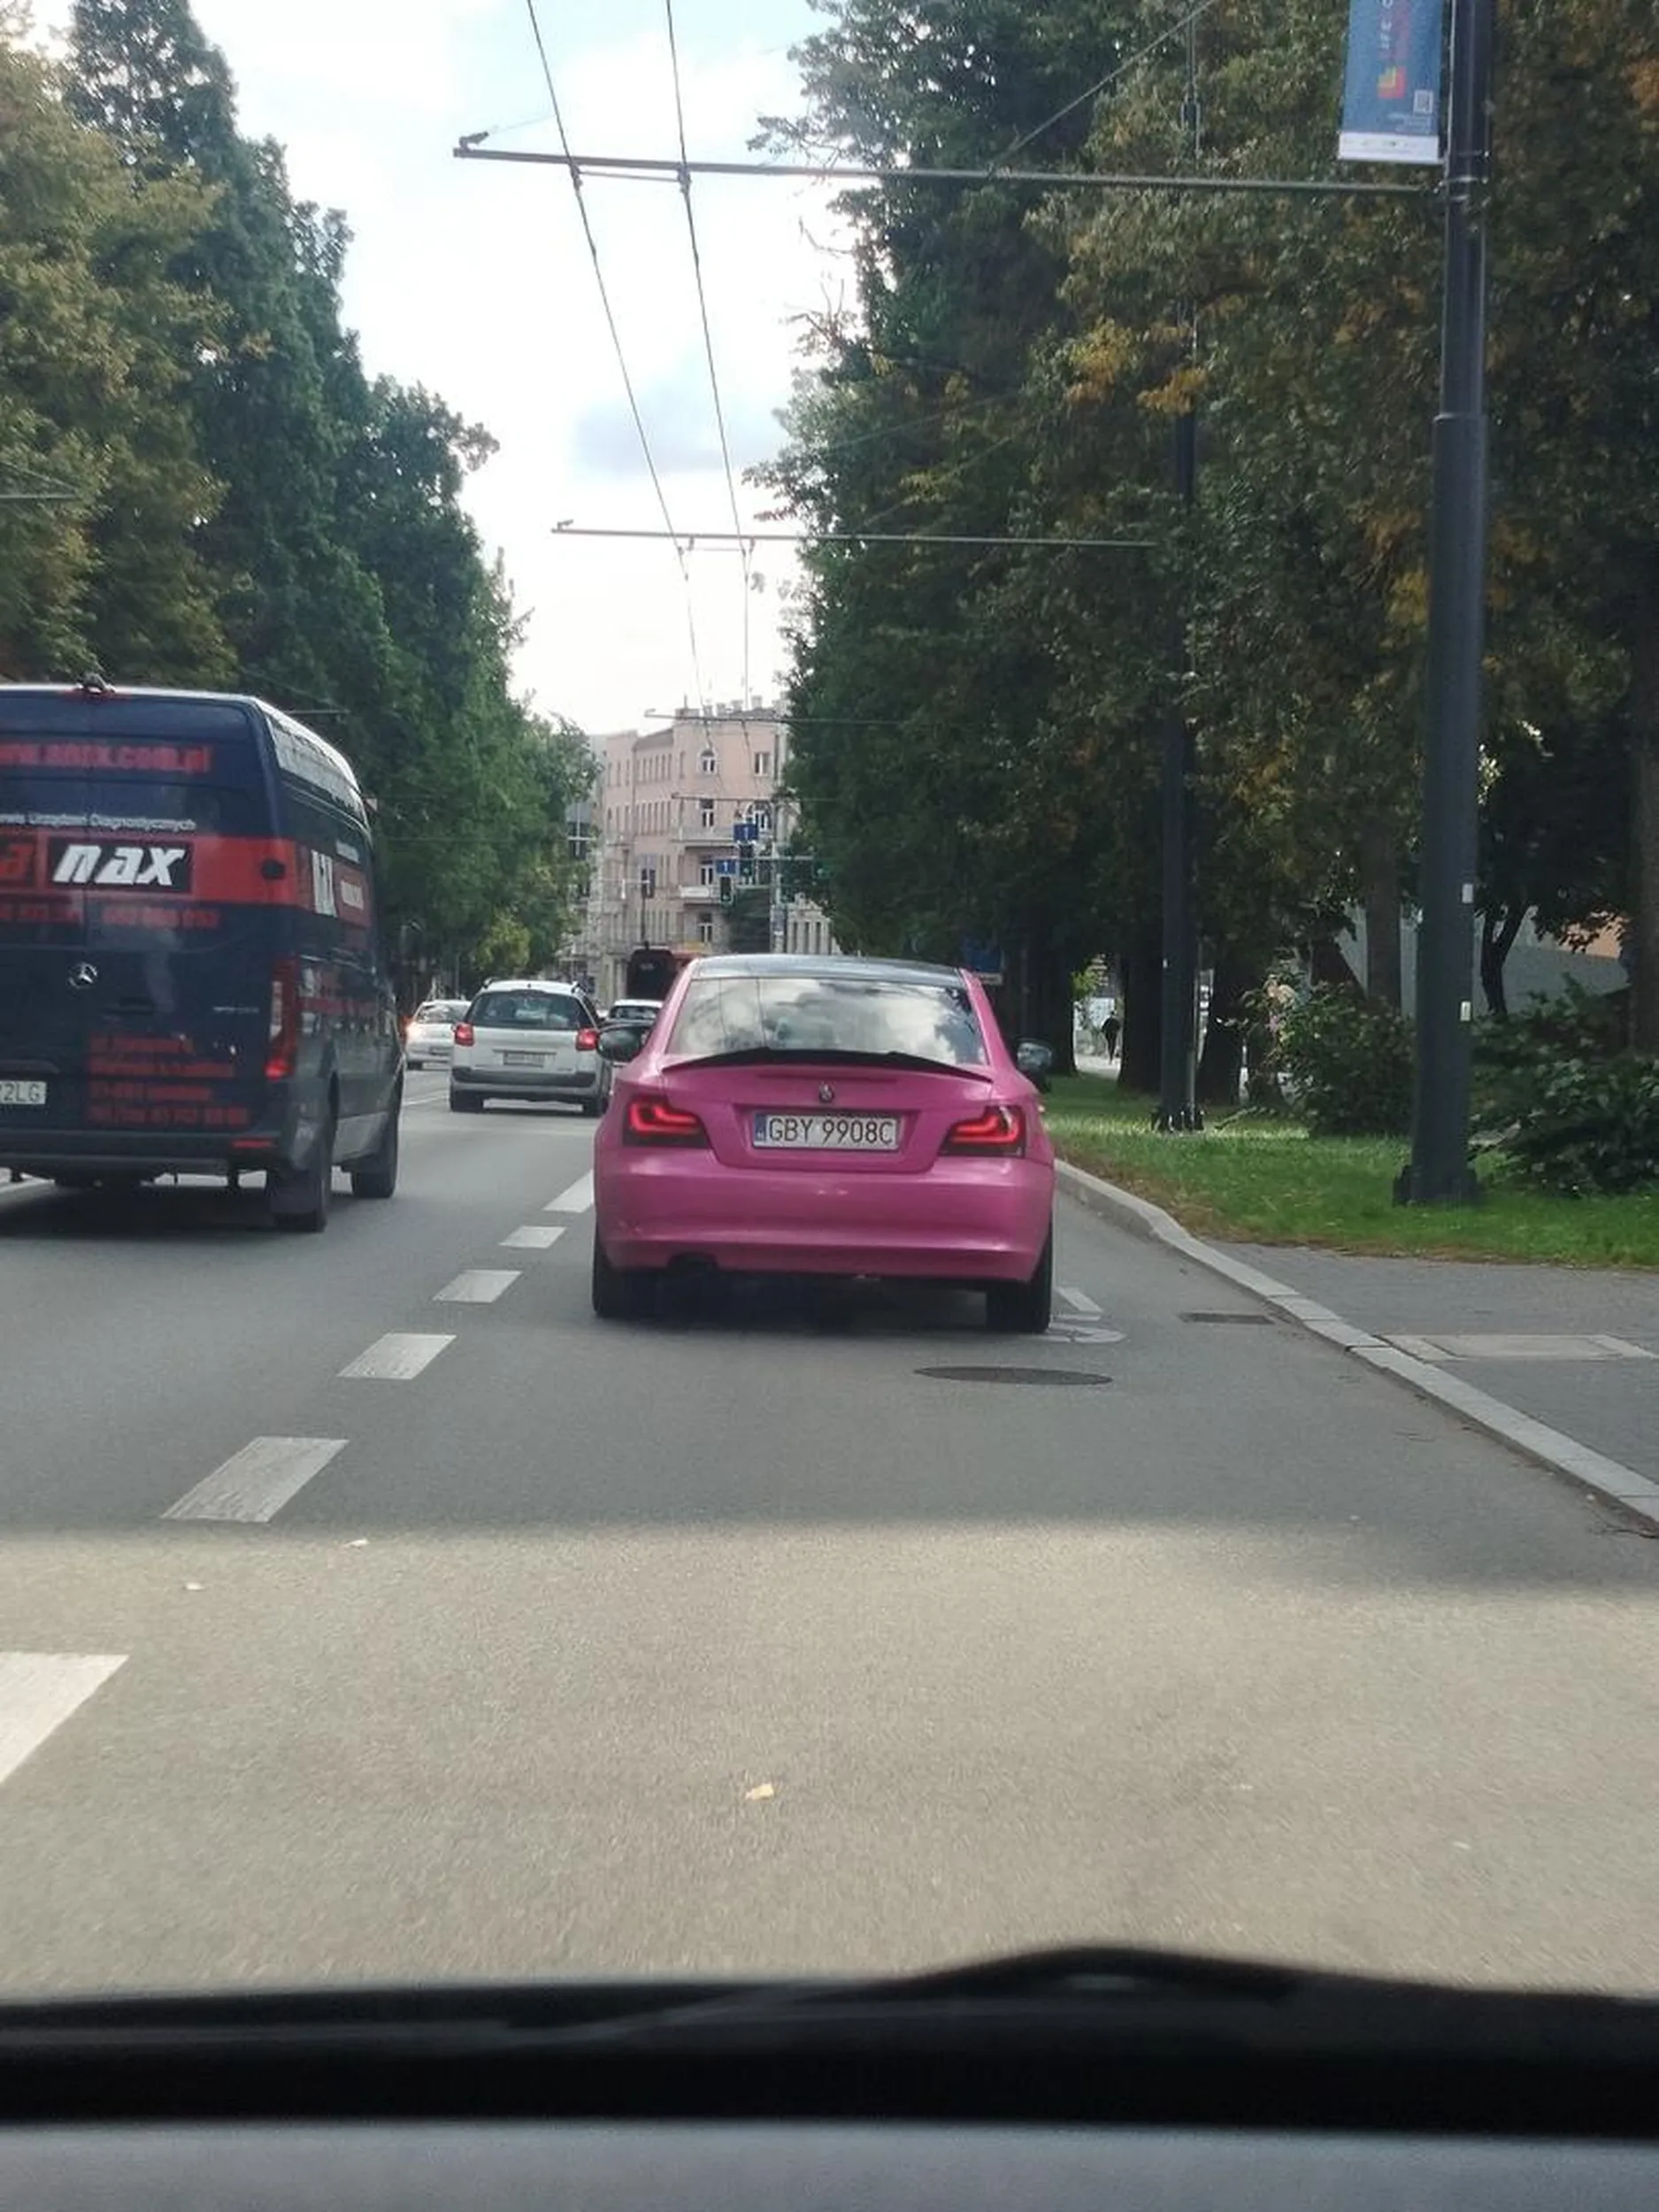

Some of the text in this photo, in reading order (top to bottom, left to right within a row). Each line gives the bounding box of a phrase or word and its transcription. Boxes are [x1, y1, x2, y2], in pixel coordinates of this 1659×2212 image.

[52, 844, 186, 886] nax
[0, 1083, 41, 1102] 2LG
[769, 1118, 894, 1146] GBY 9908C
